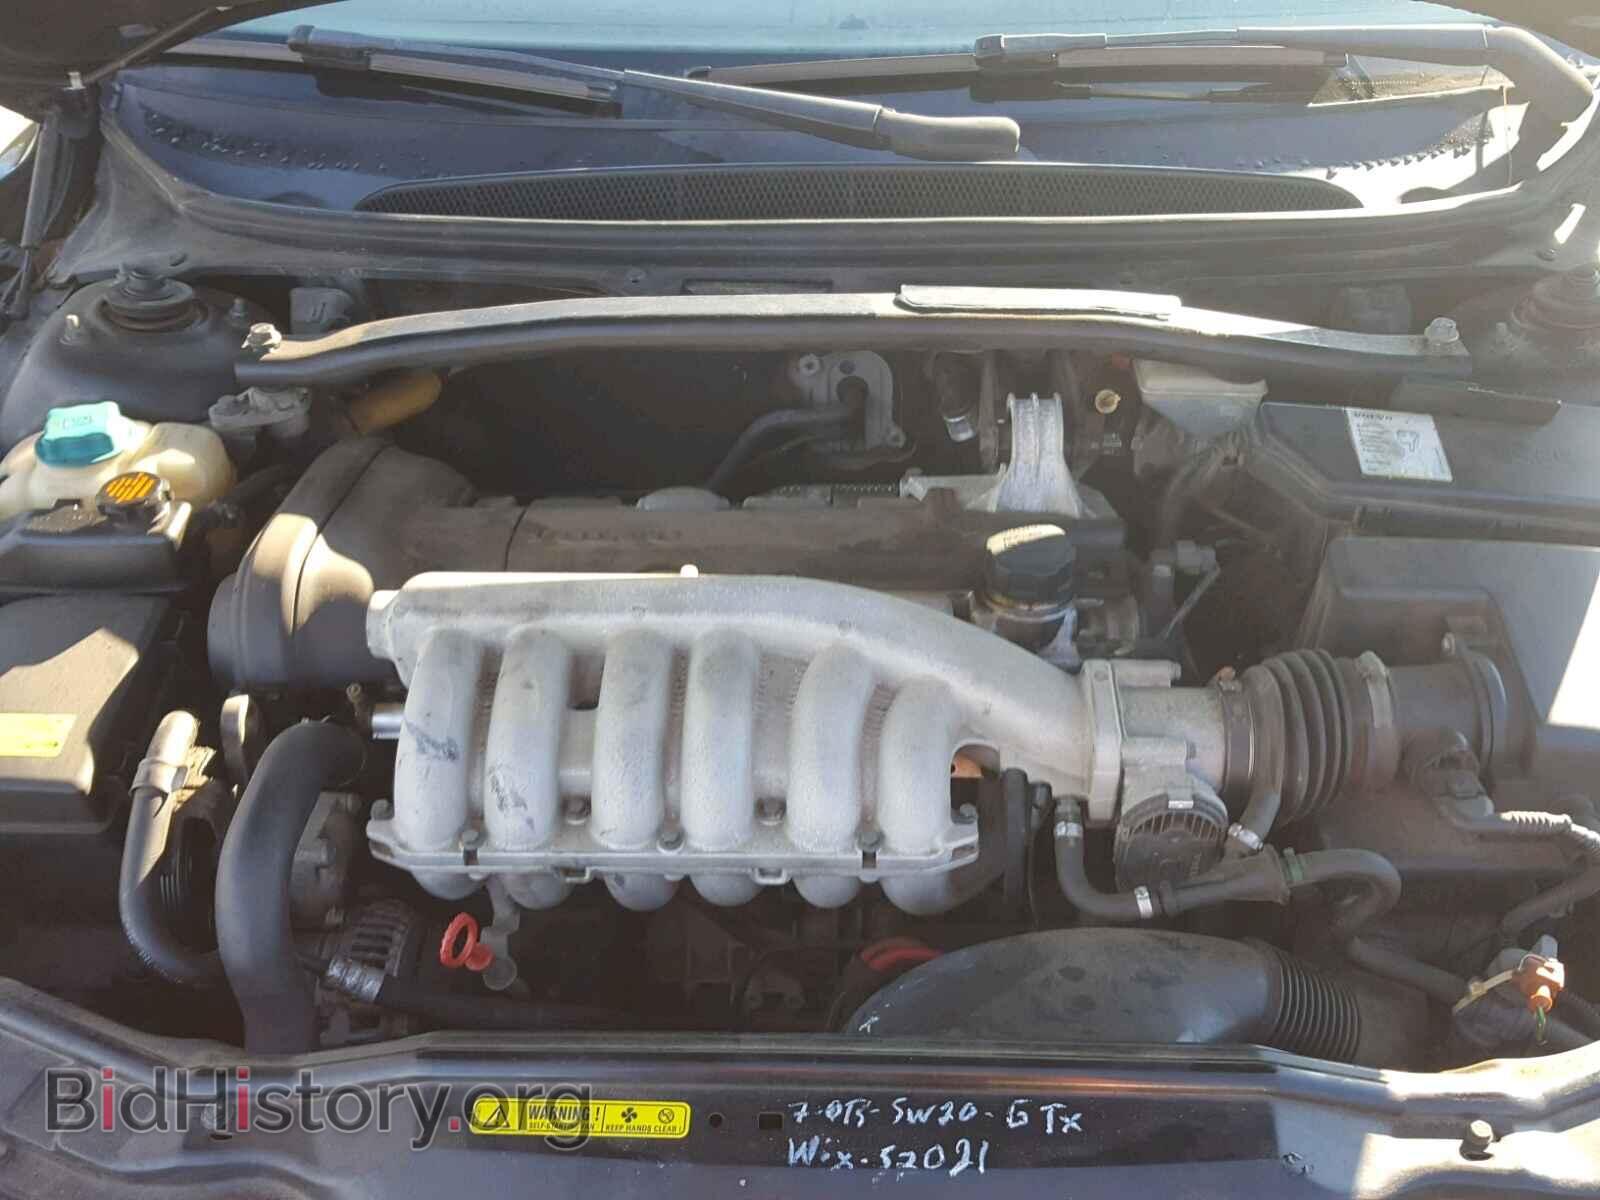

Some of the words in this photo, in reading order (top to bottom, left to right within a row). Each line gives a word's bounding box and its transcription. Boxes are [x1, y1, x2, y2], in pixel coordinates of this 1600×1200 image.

[529, 1105, 590, 1121] WARNING
[606, 1124, 624, 1132] KEEP
[626, 1124, 652, 1132] HANDS
